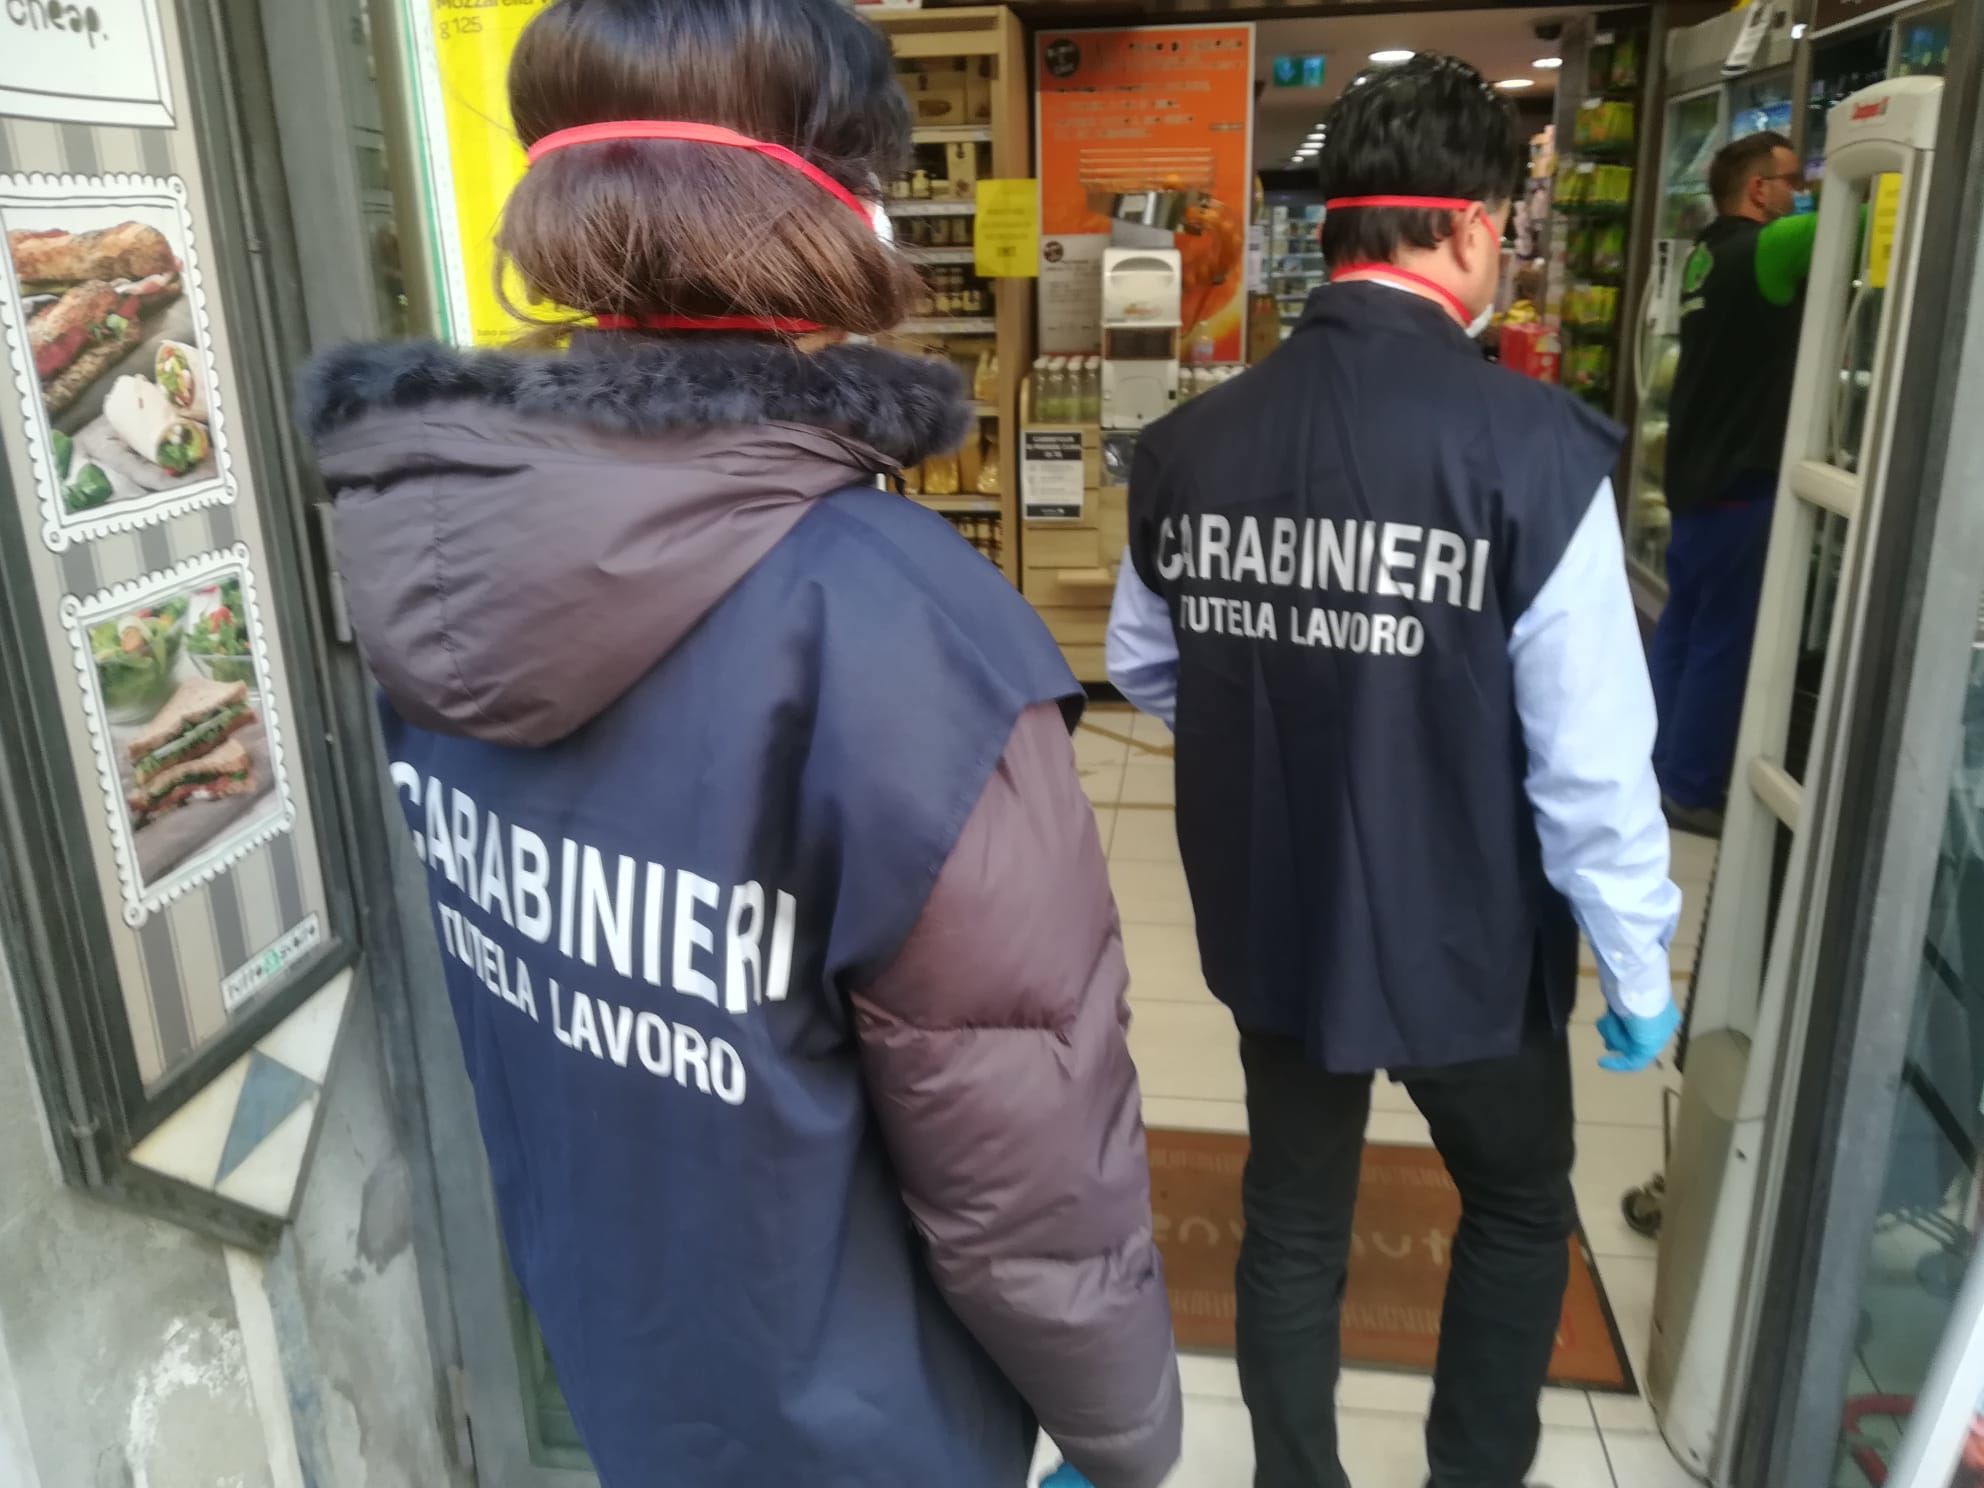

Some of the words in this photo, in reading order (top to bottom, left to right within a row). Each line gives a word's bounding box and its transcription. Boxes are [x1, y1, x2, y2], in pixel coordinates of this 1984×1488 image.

[452, 16, 483, 34] 125
[1156, 513, 1491, 612] CARABINIERI
[1180, 595, 1278, 642] TUTELA
[1291, 607, 1425, 658] LAVORO
[390, 761, 797, 1014] CARABINIERI
[437, 901, 539, 1024] TUTELA
[549, 977, 747, 1106] LAVORO
